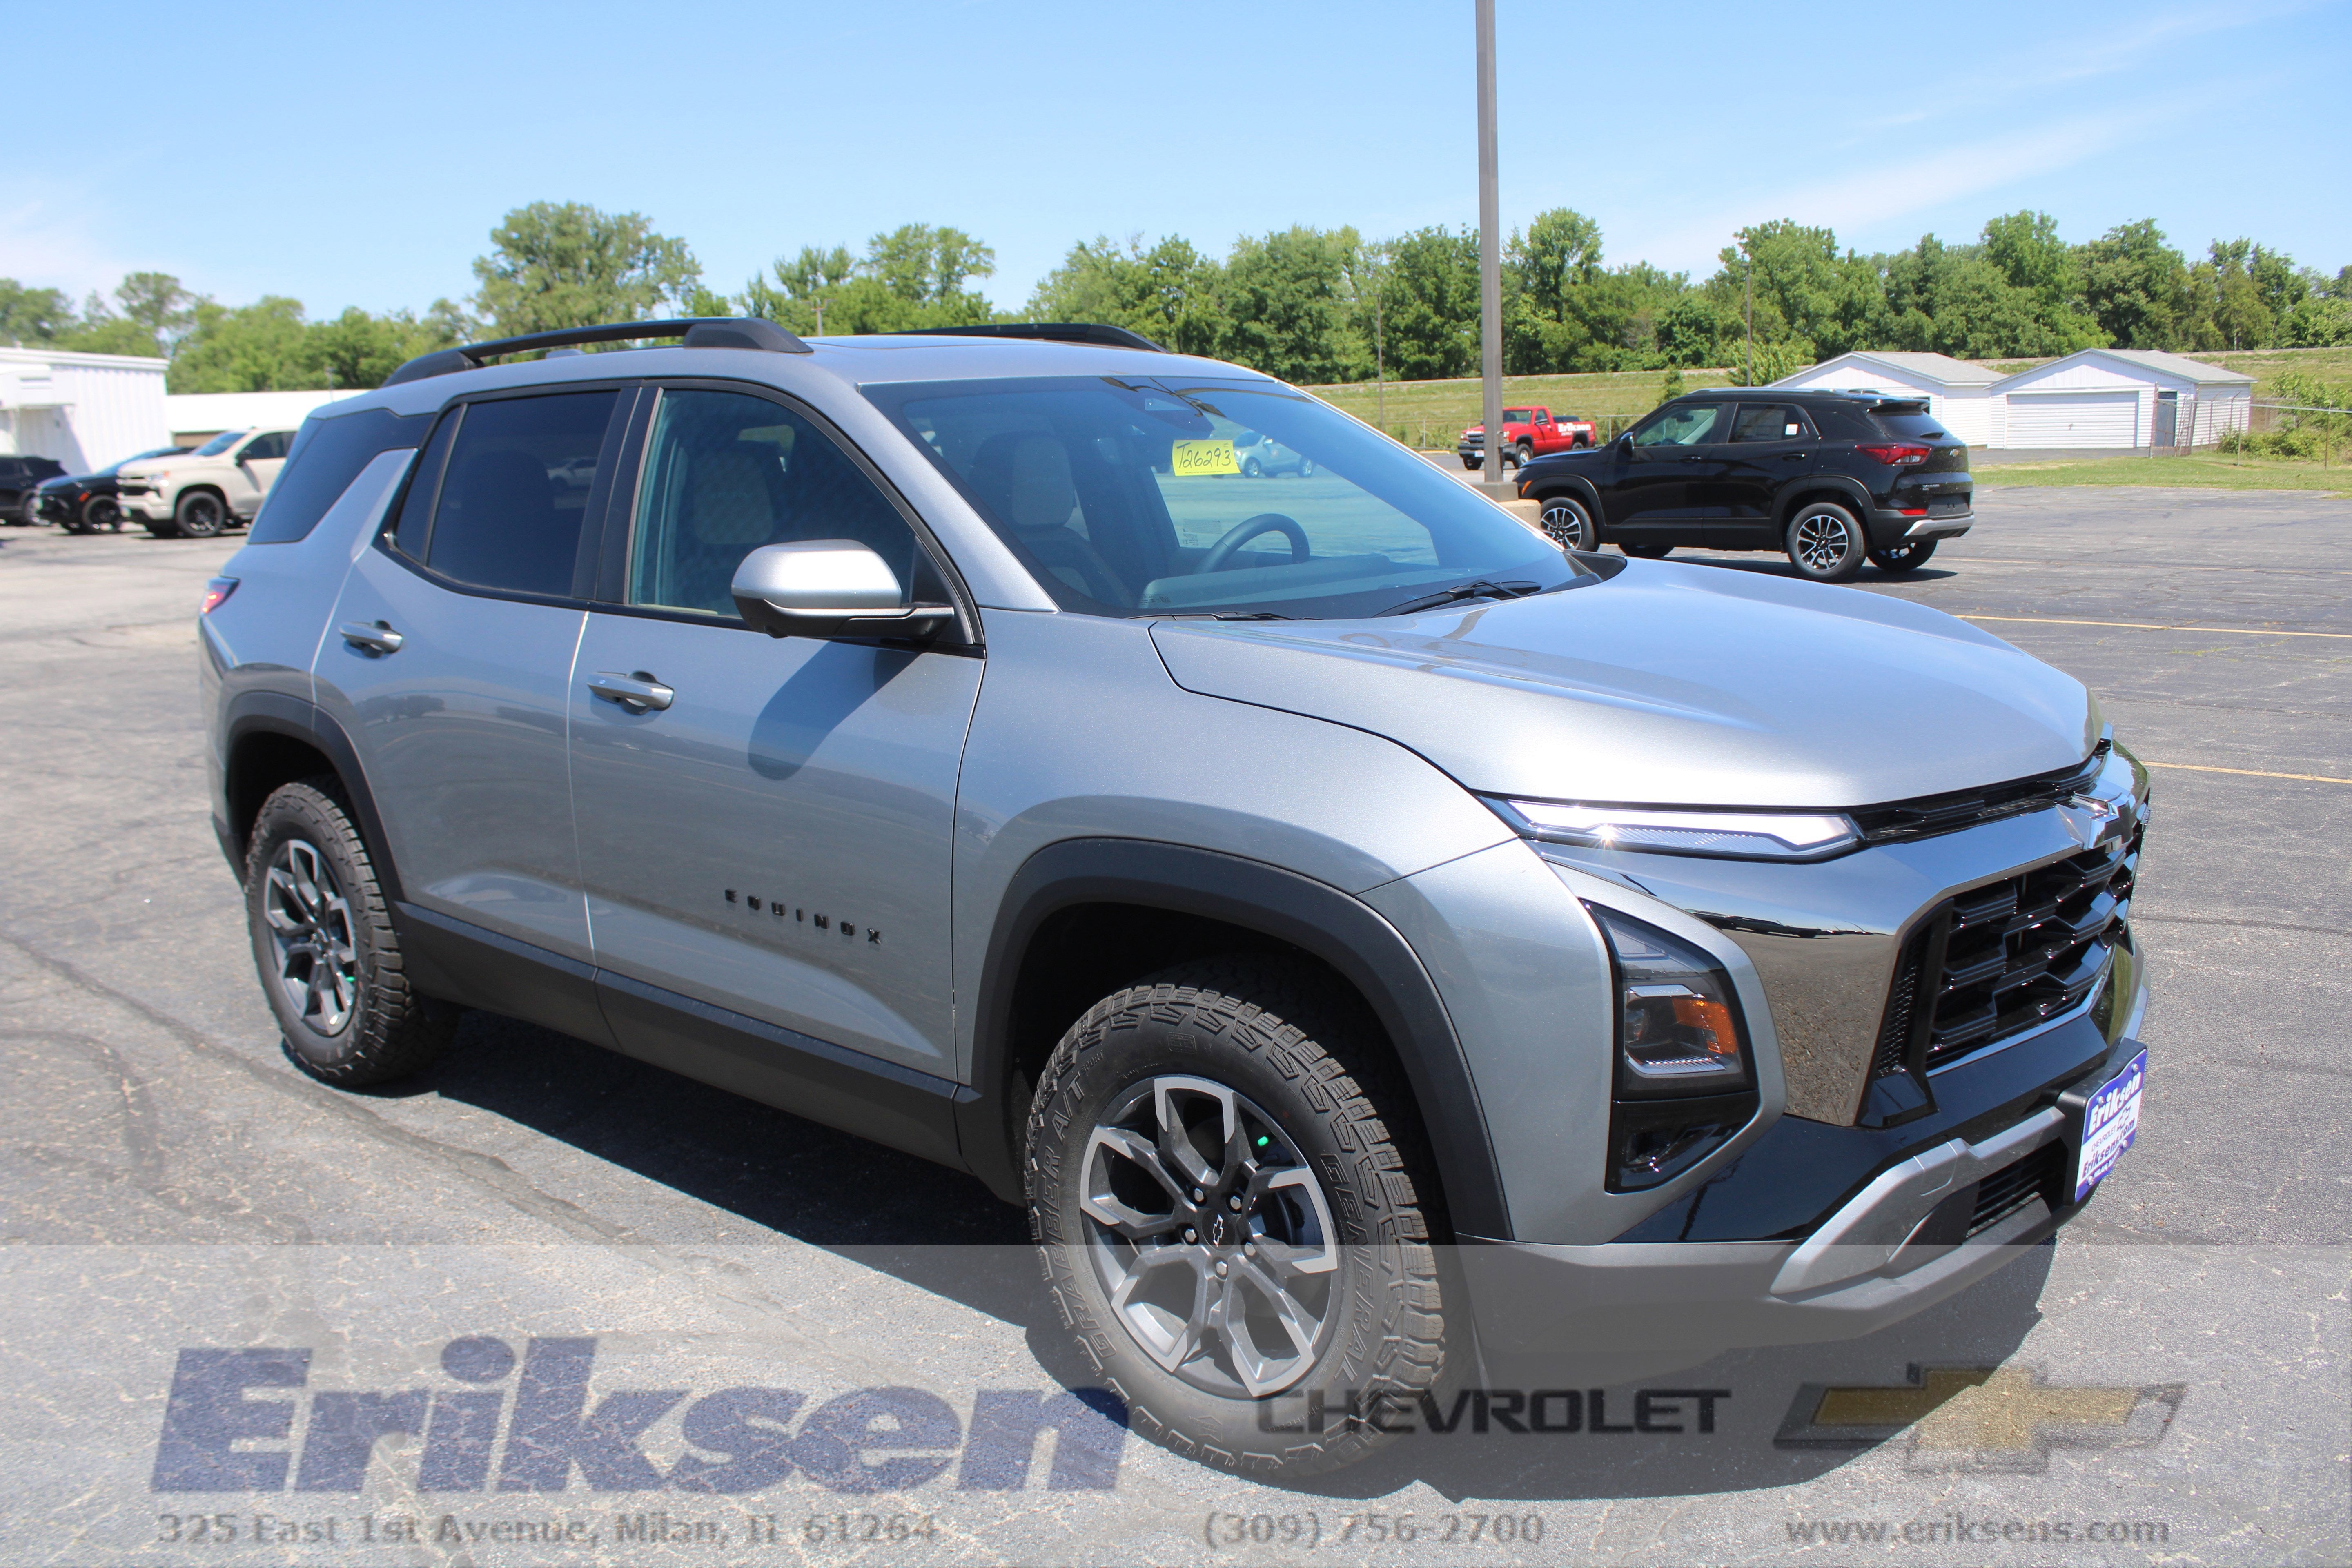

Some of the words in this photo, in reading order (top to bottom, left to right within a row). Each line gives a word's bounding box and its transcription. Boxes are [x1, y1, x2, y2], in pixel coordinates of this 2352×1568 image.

[1176, 442, 1231, 468] T26293
[725, 889, 881, 944] EQUINOX
[1052, 1071, 1085, 1145] A/T
[2087, 1071, 2141, 1136] Eriksen
[2091, 1124, 2117, 1152] CHEVROLET
[1042, 1145, 1117, 1359] GRABBER
[1320, 1154, 1375, 1383] GENERAL
